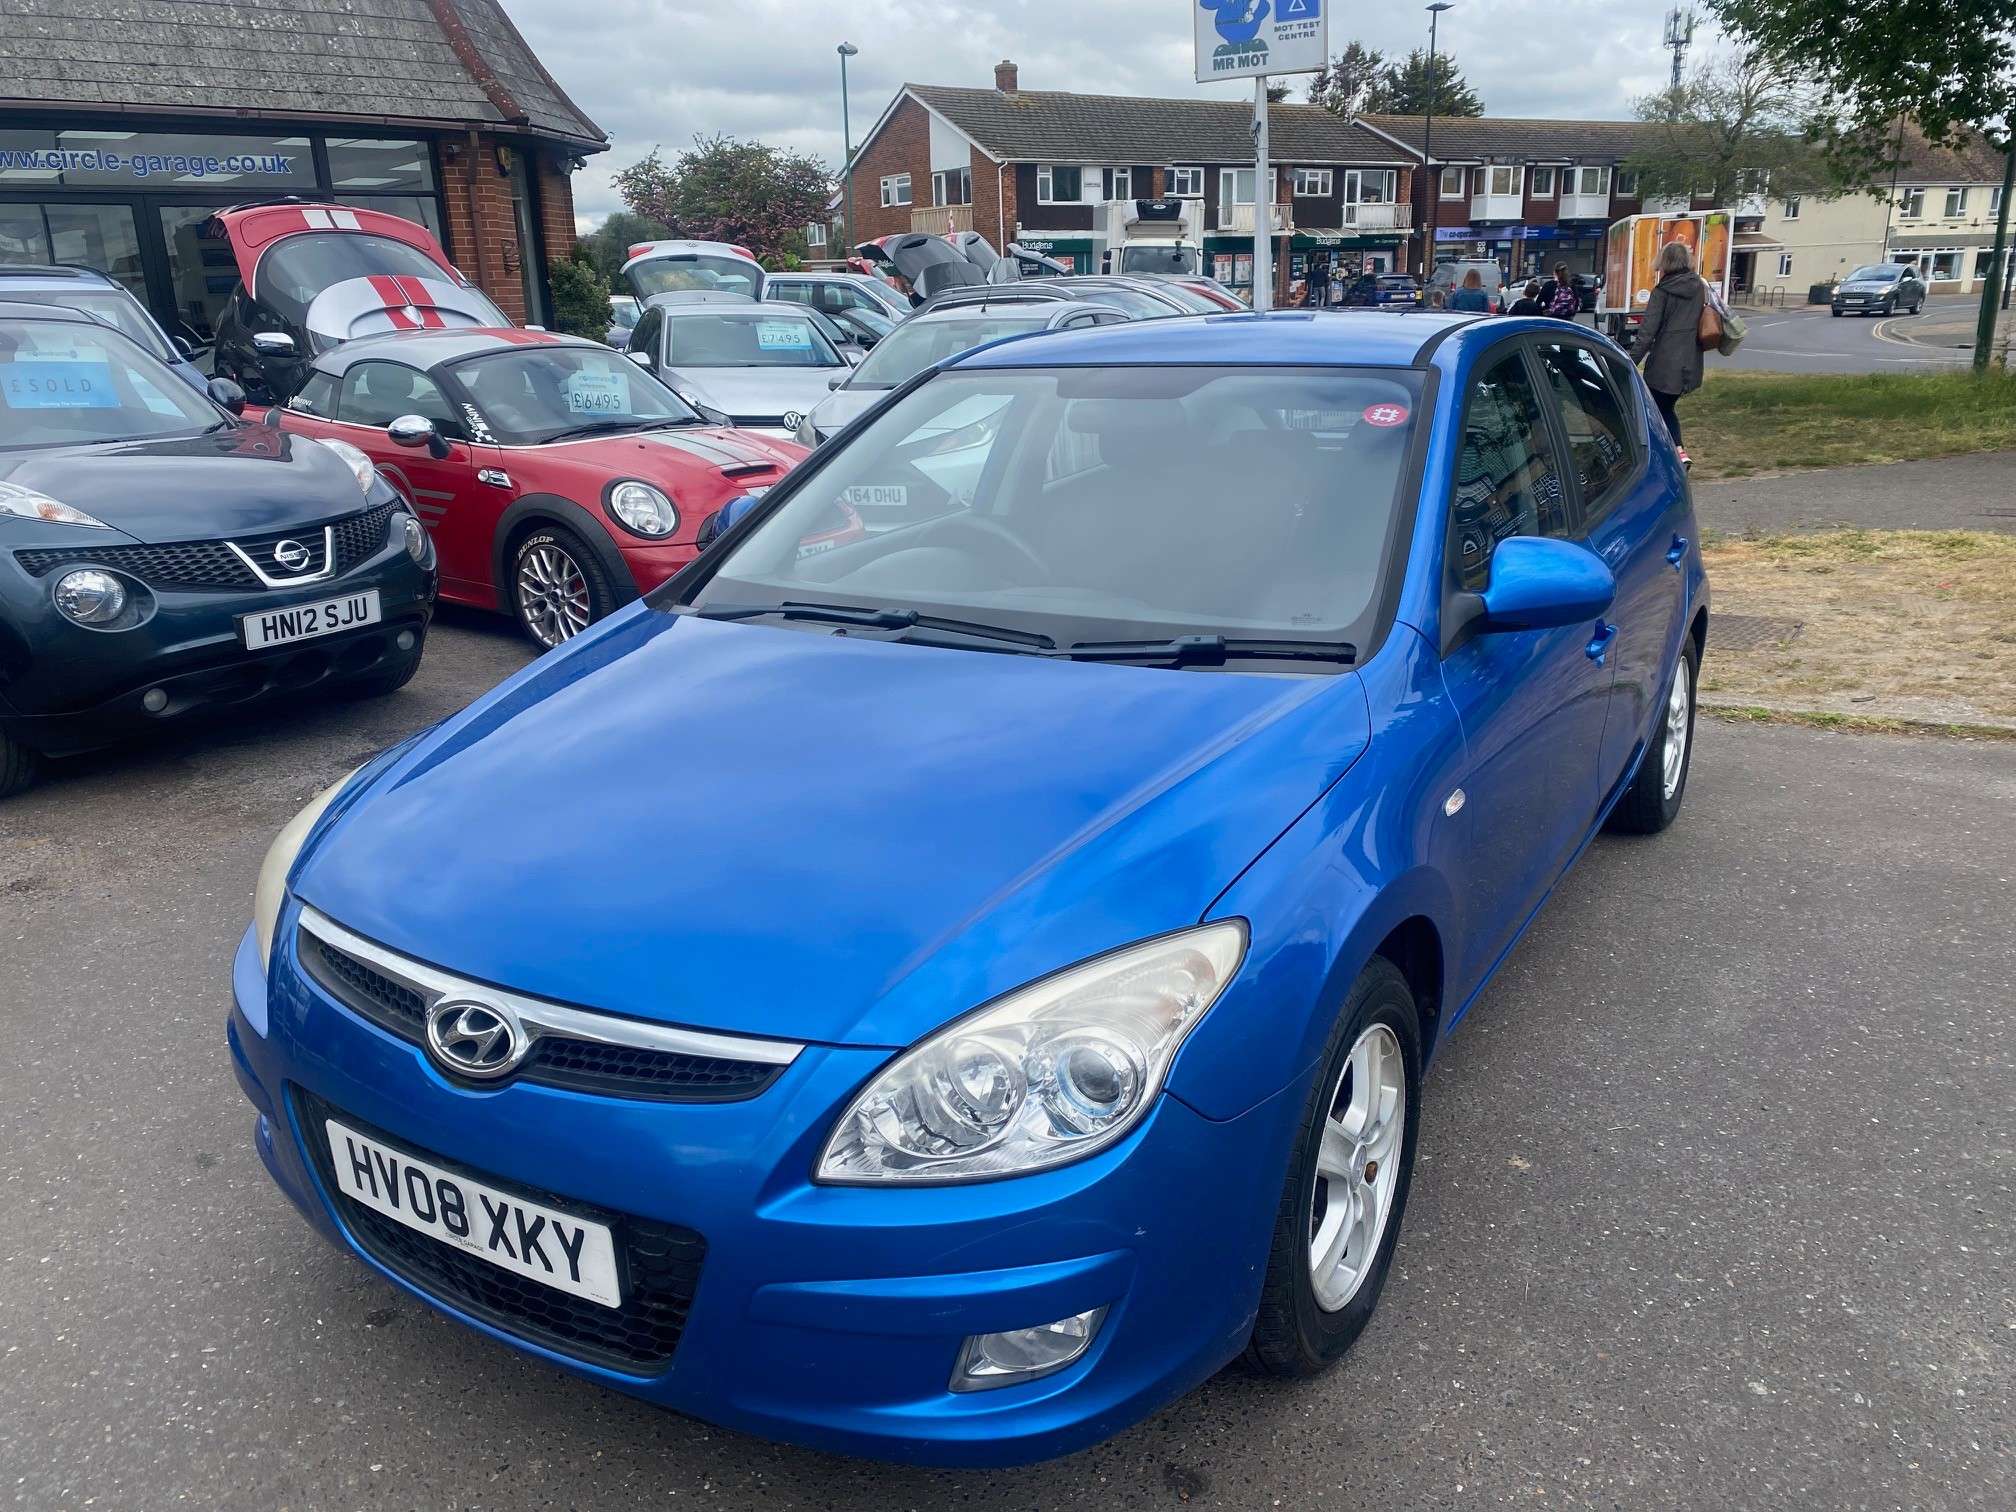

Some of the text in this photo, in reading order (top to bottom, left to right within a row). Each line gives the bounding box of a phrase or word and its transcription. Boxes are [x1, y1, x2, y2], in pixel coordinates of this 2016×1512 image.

[1274, 21, 1321, 32] MOT TEST
[1278, 31, 1316, 41] CENTRE
[1213, 53, 1269, 71] MR MOT
[761, 334, 801, 344] £7495
[574, 392, 621, 410] £6495
[518, 536, 554, 560] DUNLOP
[262, 597, 368, 642] HN12 SJU
[346, 1136, 585, 1283] HV08 XKY
